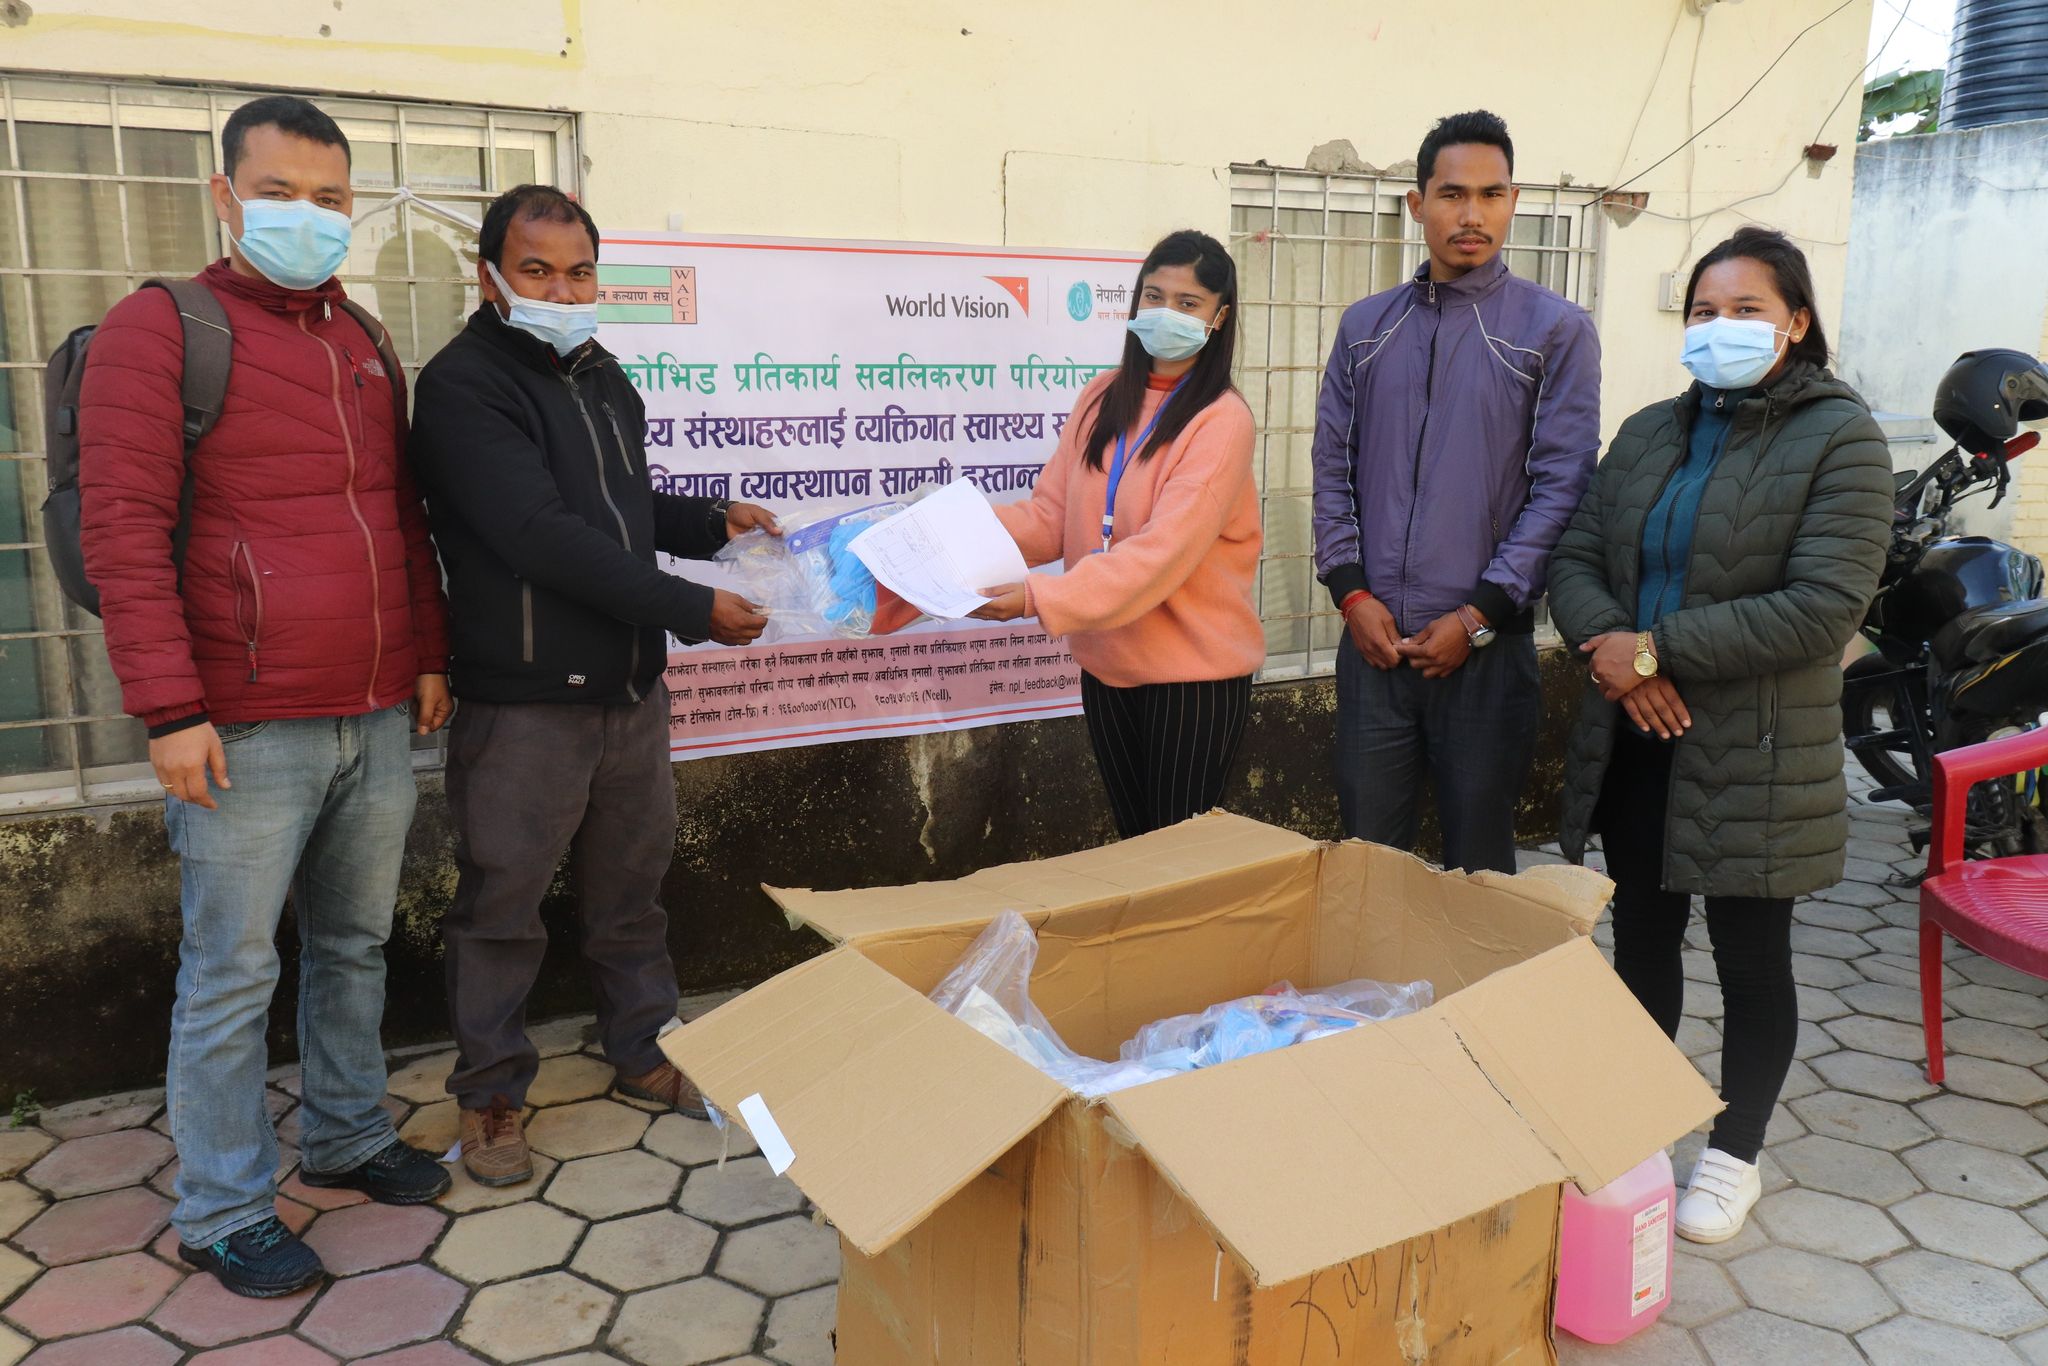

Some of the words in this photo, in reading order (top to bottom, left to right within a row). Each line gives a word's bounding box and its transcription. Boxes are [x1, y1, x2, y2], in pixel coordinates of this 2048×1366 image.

[612, 290, 648, 302] कल्याण
[653, 289, 670, 302] संघ
[886, 293, 946, 318] World
[951, 295, 1009, 319] Vision
[1096, 283, 1127, 303] नेपाली
[734, 352, 841, 392] प्रतिकार्य
[855, 352, 997, 392] सवलिकरण
[1010, 353, 1122, 392] परियोज
[684, 407, 847, 449] संस्थाहरूलाई
[855, 404, 956, 444] व्यक्तिगत
[963, 413, 1045, 443] स्वास्थ्य
[647, 464, 732, 500] भियान
[741, 468, 872, 500] व्यवस्थापन
[740, 657, 761, 671] गरेका
[764, 653, 776, 672] कुनै
[780, 652, 818, 666] क्रियाकलाप
[821, 648, 833, 662] प्रति
[837, 647, 858, 663] यहाँको
[890, 643, 911, 661] गुनासो
[914, 644, 927, 655] तथा
[969, 639, 987, 653] भएमा
[990, 637, 1007, 648] तलका
[1010, 632, 1025, 647] निम्न
[1027, 634, 1047, 644] माध्यम
[750, 678, 774, 693] परिचय
[777, 677, 794, 690] गोप्य
[798, 674, 815, 688] राखी
[818, 670, 849, 688] तोकिएको
[969, 658, 996, 673] प्रतिक्रिया
[998, 659, 1010, 670] तथा
[1012, 655, 1031, 668] नतिजा
[1033, 651, 1061, 666] जानकारी
[690, 708, 721, 724] टेलिफोन
[1009, 673, 1082, 694] npl_feedback@wvi.
